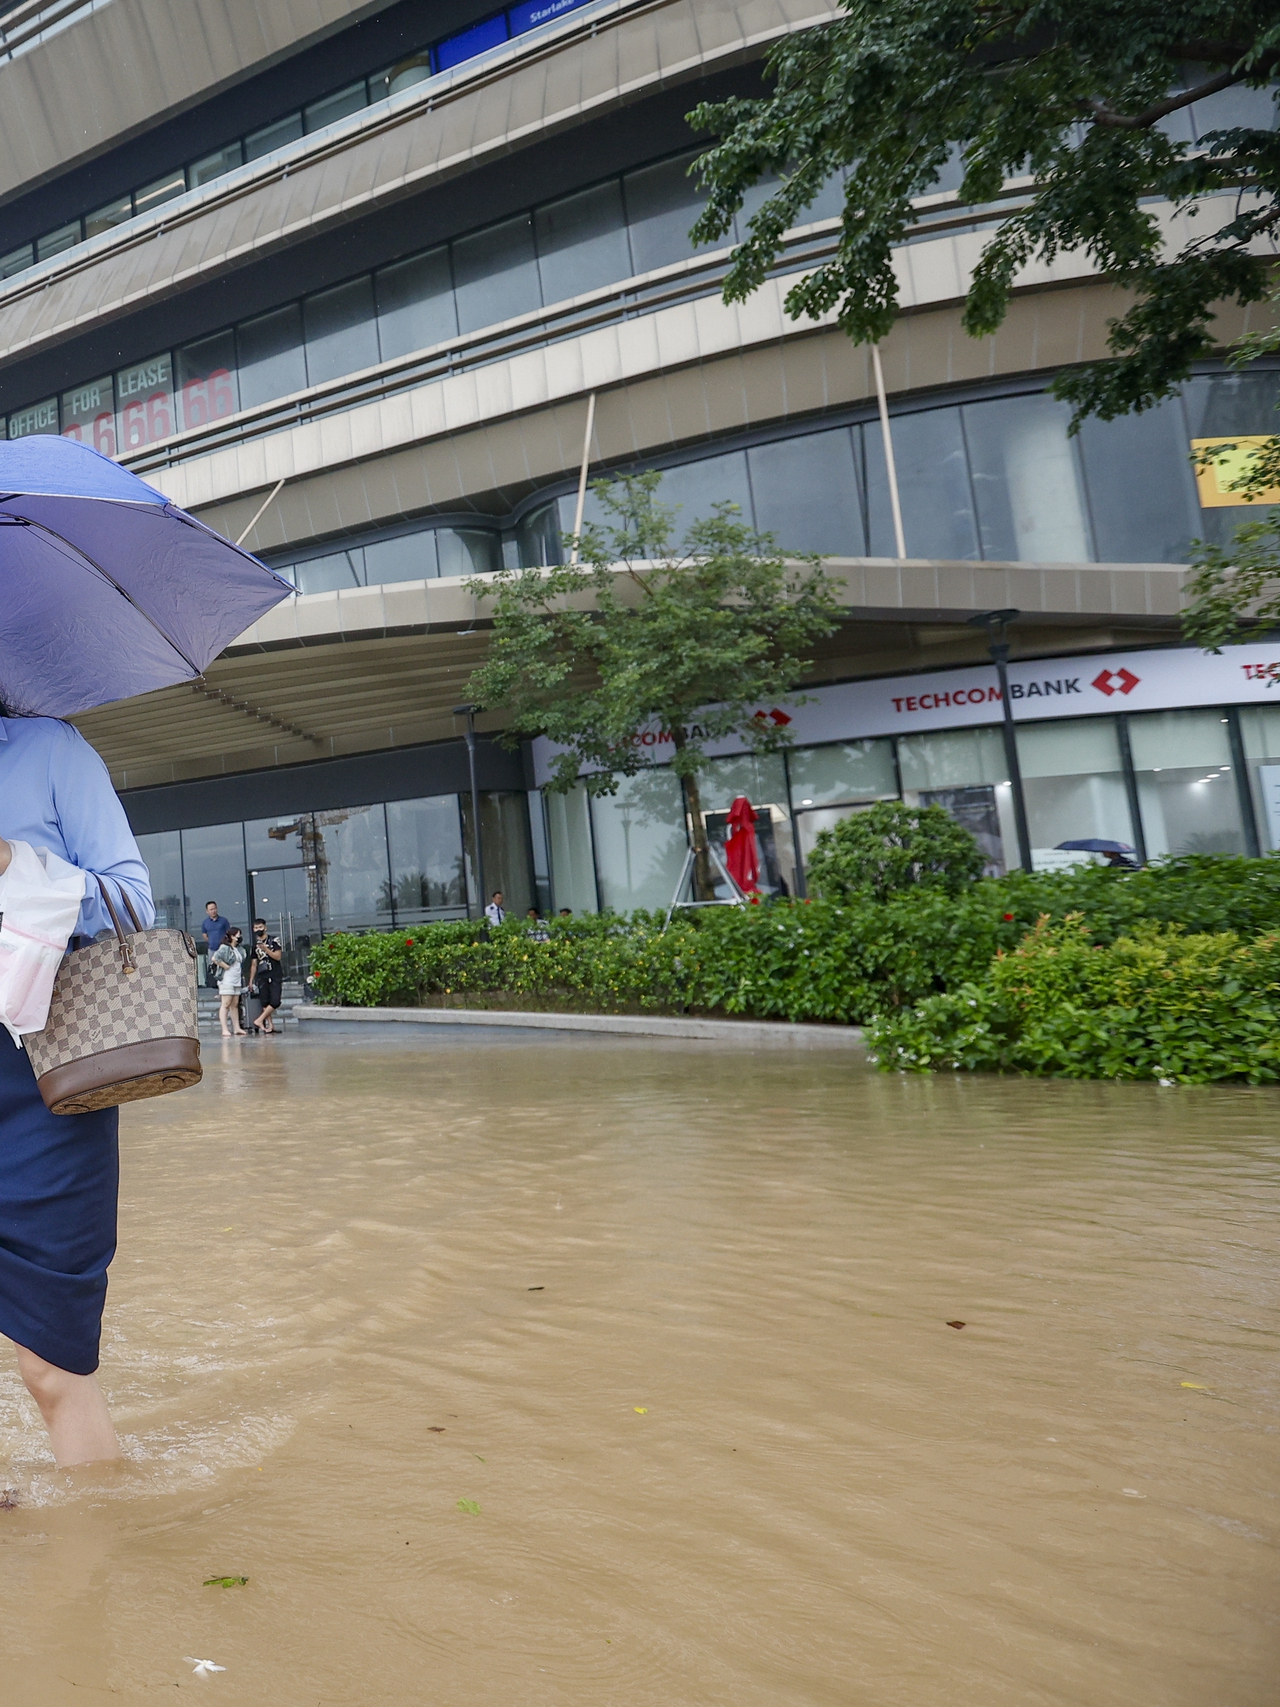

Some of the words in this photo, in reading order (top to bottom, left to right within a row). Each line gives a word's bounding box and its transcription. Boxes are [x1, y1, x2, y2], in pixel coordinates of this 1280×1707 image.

[9, 404, 57, 439] OFFICE
[72, 386, 101, 415] FOR
[119, 360, 168, 398] LEASE
[892, 678, 1082, 712] TECHCOMBANK
